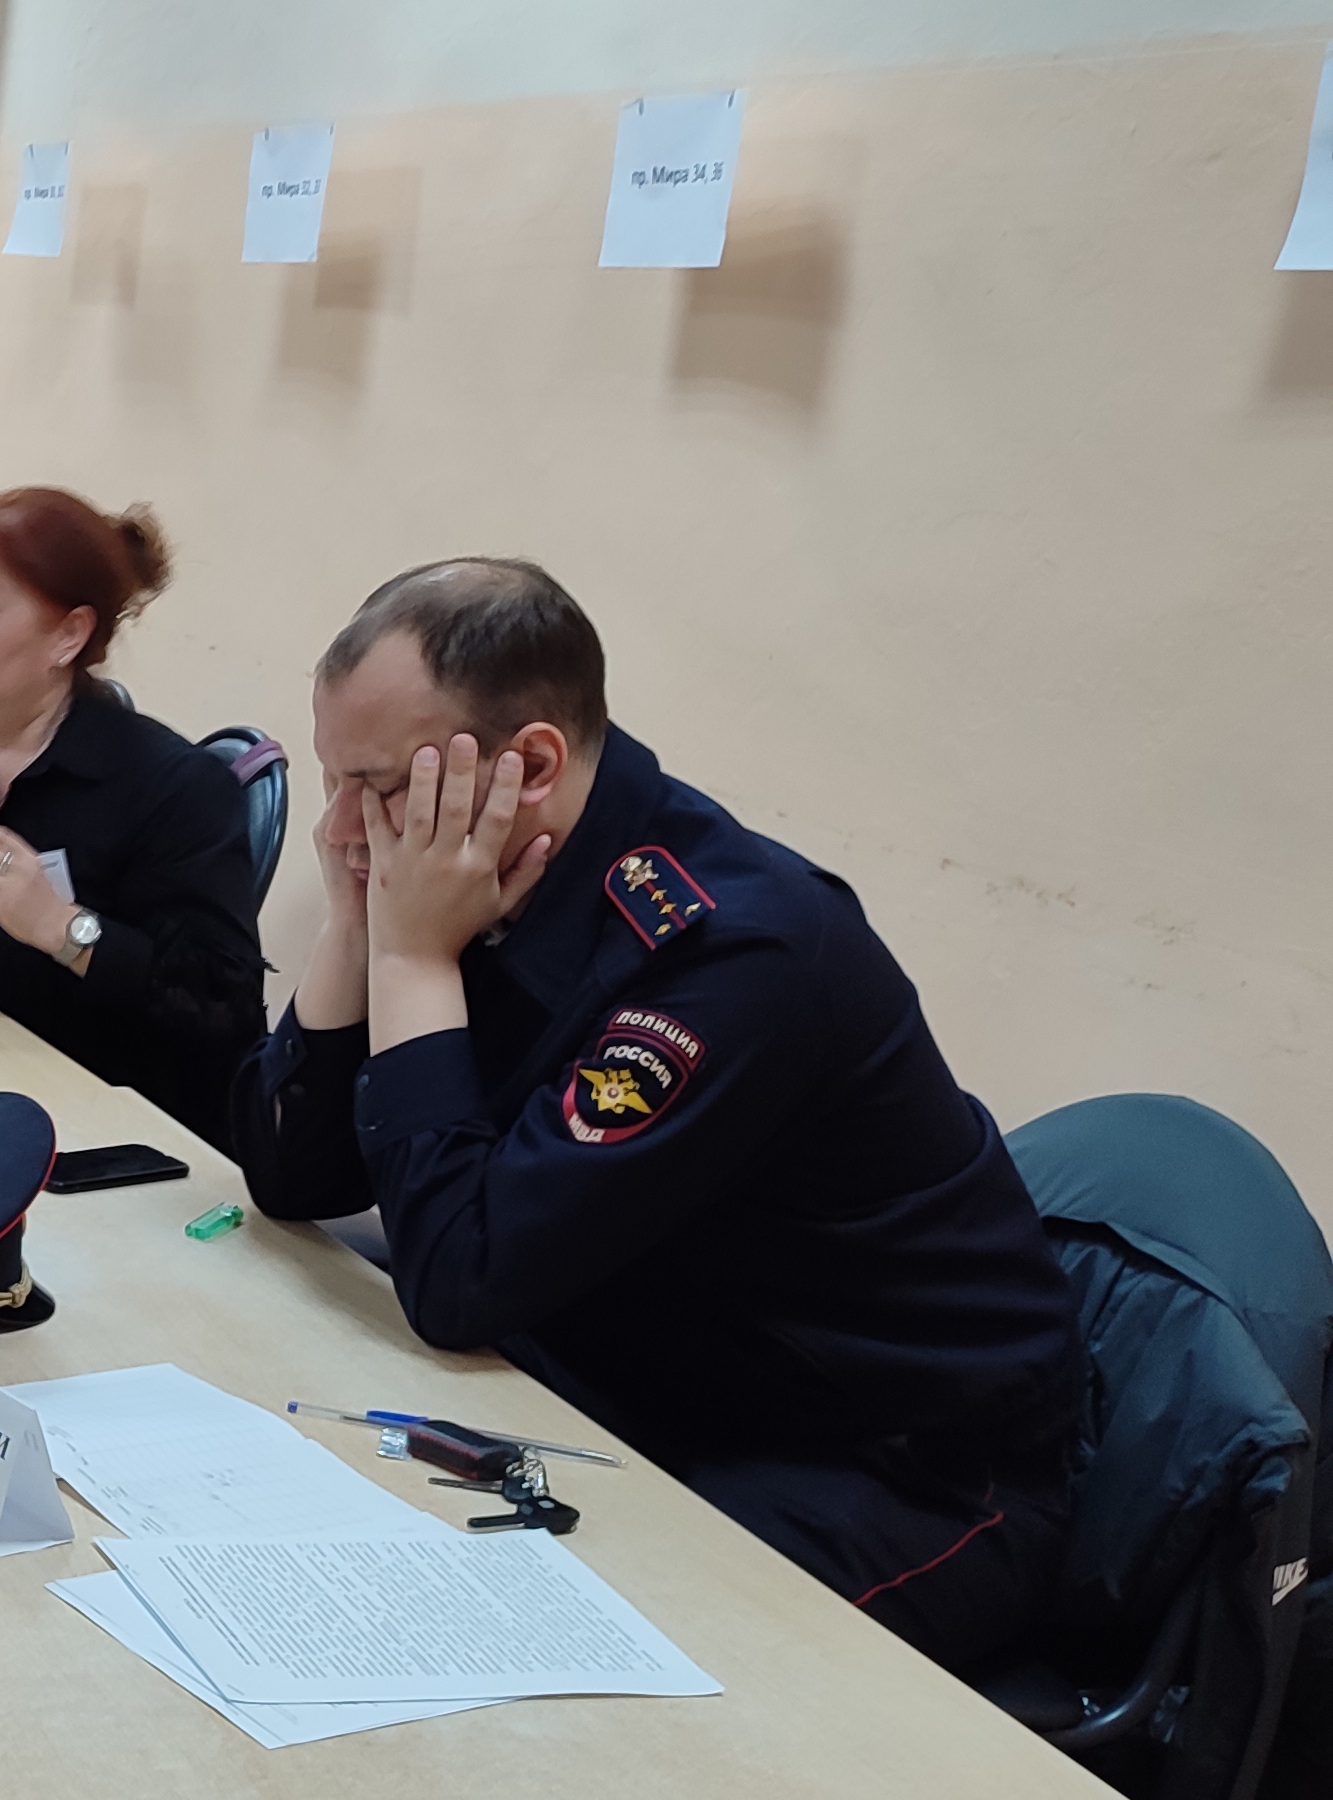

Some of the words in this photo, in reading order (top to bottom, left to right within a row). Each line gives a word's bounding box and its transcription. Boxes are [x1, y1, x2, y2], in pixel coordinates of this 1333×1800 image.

[651, 165, 690, 188] Мира
[615, 1011, 700, 1059] ПОЛИЦИЯ
[603, 1045, 673, 1089] РОССИЯ
[568, 1111, 606, 1143] МВД
